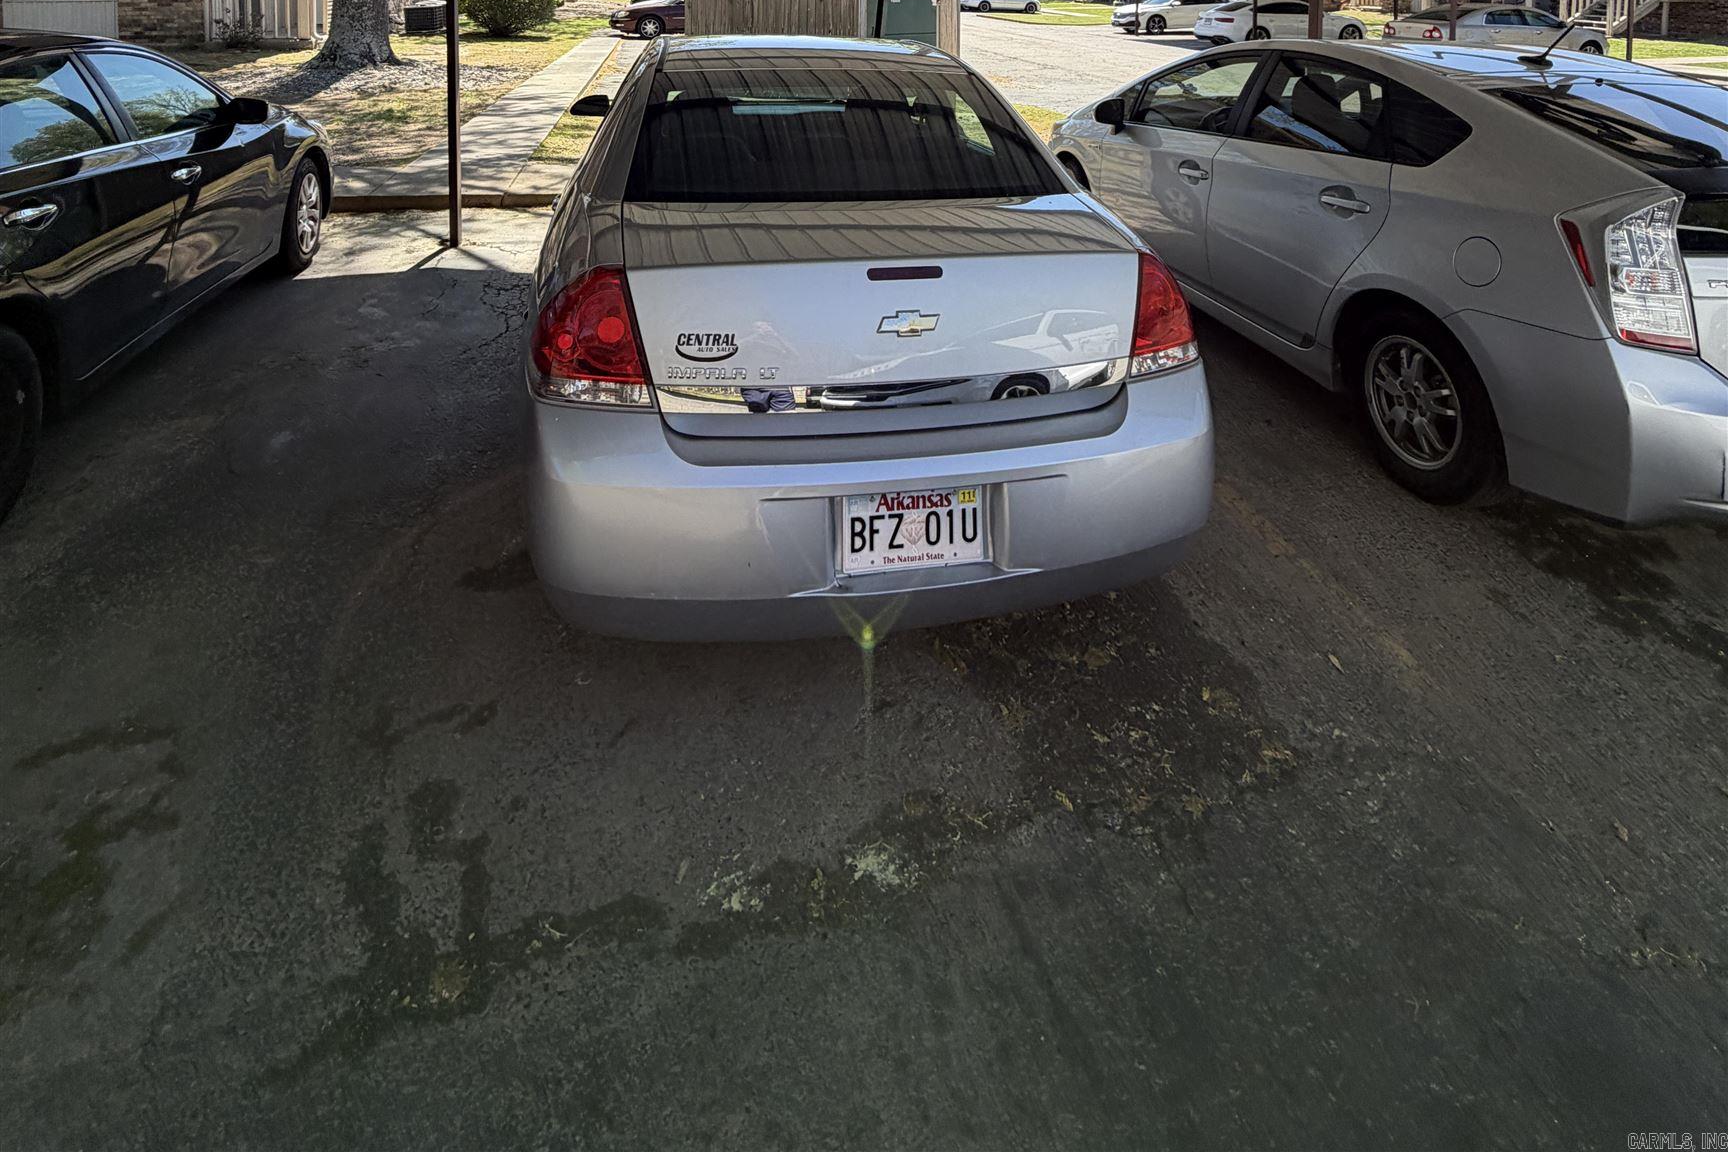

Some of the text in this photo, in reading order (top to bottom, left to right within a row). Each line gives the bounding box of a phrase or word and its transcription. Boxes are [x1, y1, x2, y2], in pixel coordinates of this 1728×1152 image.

[677, 333, 738, 346] CENTRAL
[668, 366, 779, 379] IMPALA LT
[875, 491, 952, 513] Arkansas
[850, 507, 978, 553] BFZ 01U
[883, 552, 945, 564] The Natural State
